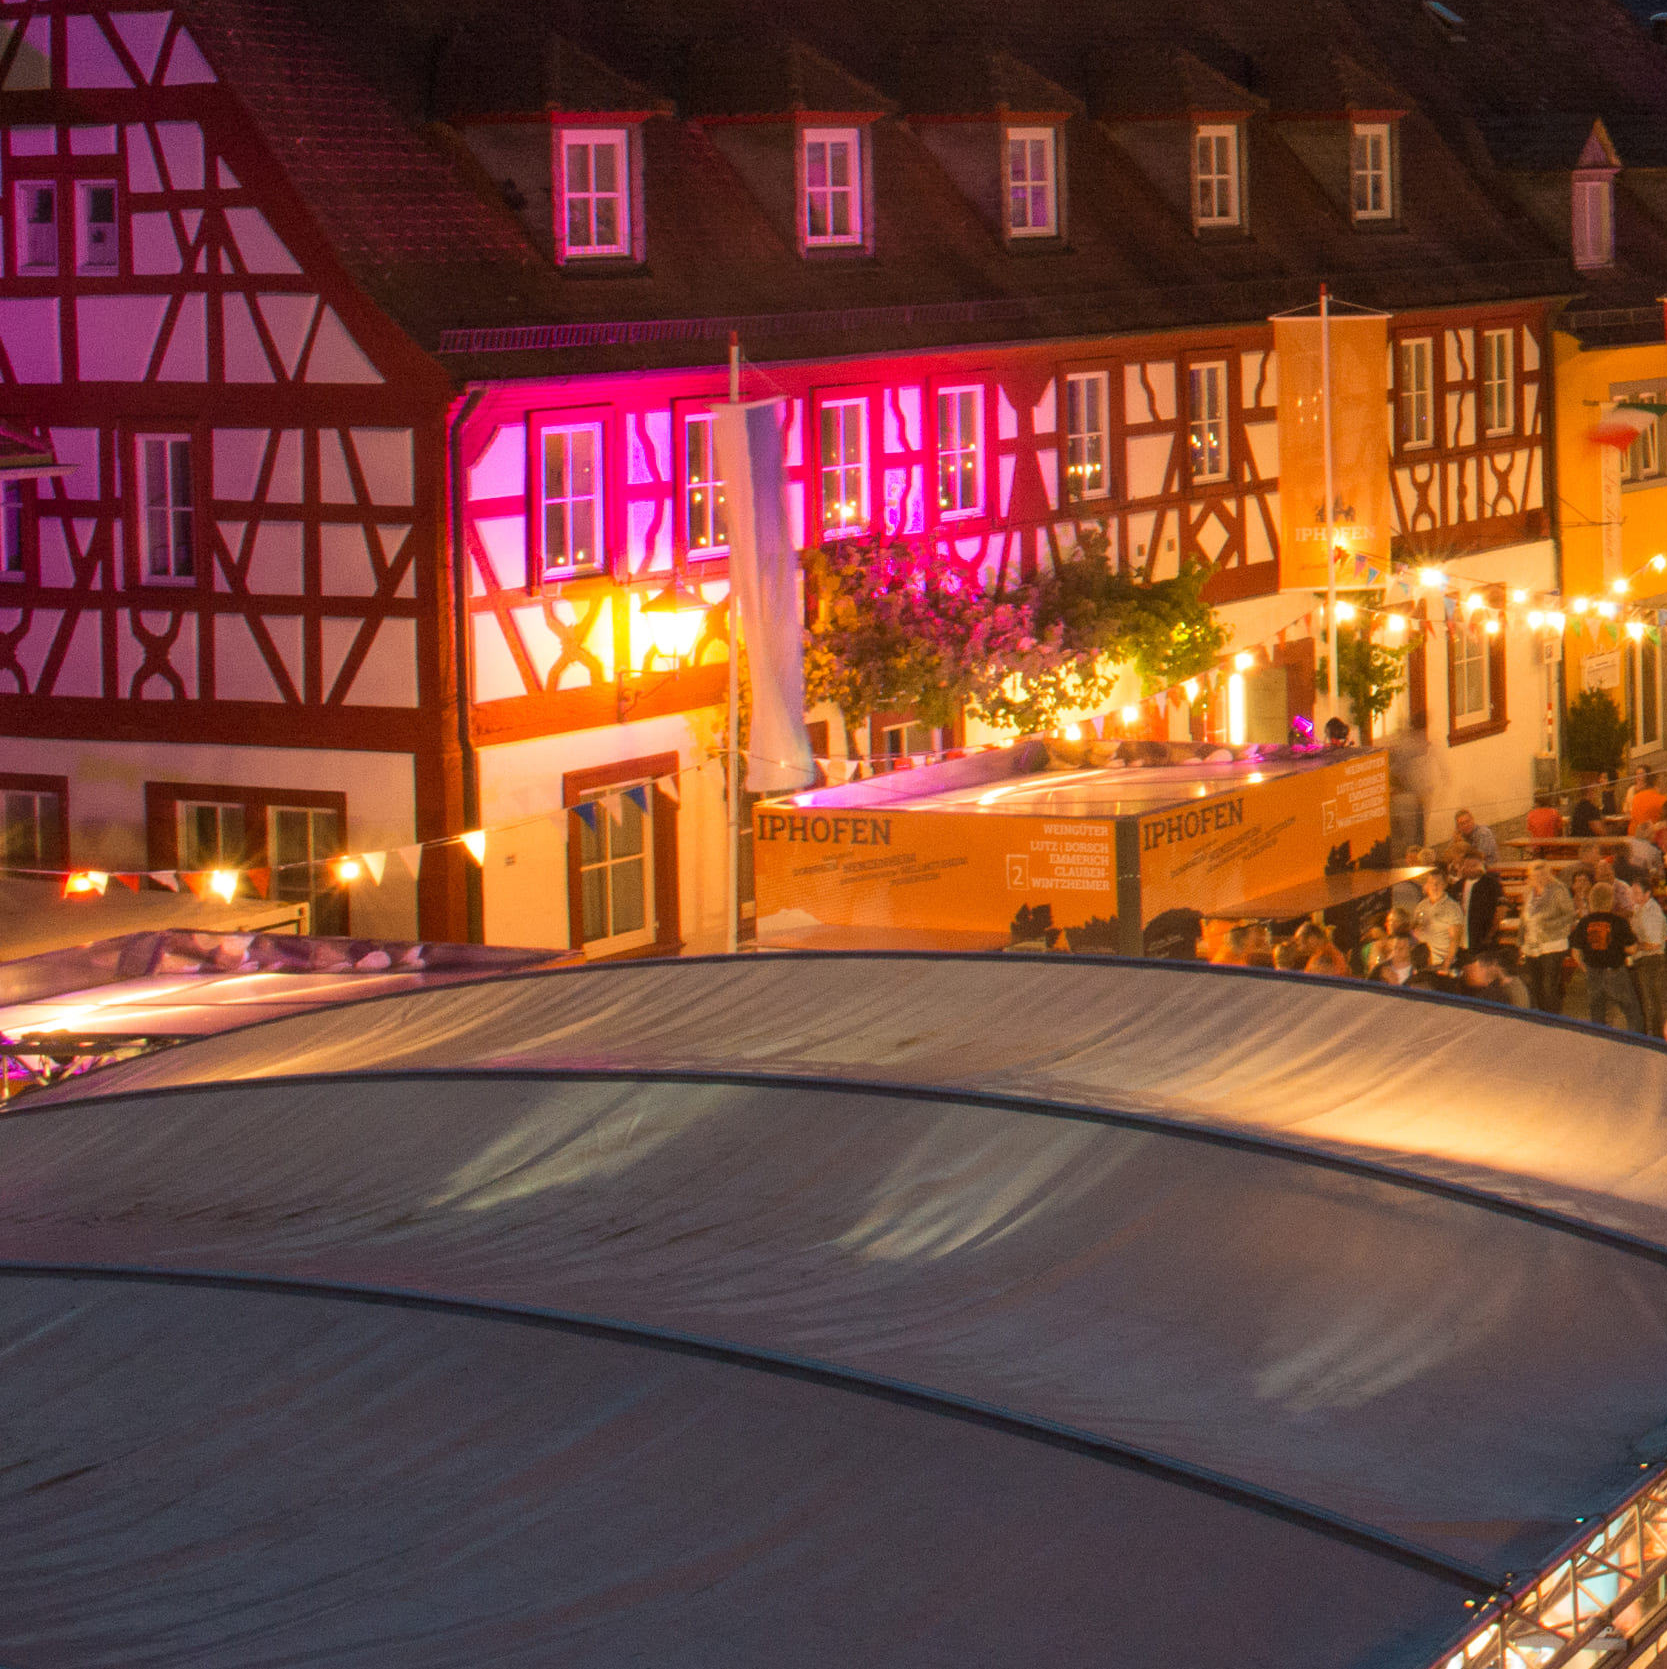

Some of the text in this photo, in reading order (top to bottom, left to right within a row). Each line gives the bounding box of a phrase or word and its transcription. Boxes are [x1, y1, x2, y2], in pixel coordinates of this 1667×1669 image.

[757, 814, 893, 846] IPHOFEN
[1043, 823, 1109, 836] WEINGÜTER
[1143, 798, 1245, 851] IPHOFEN
[1030, 840, 1109, 854] LUTZ DORSCH
[1049, 854, 1110, 866] EMMERICH
[1012, 865, 1024, 886] 2
